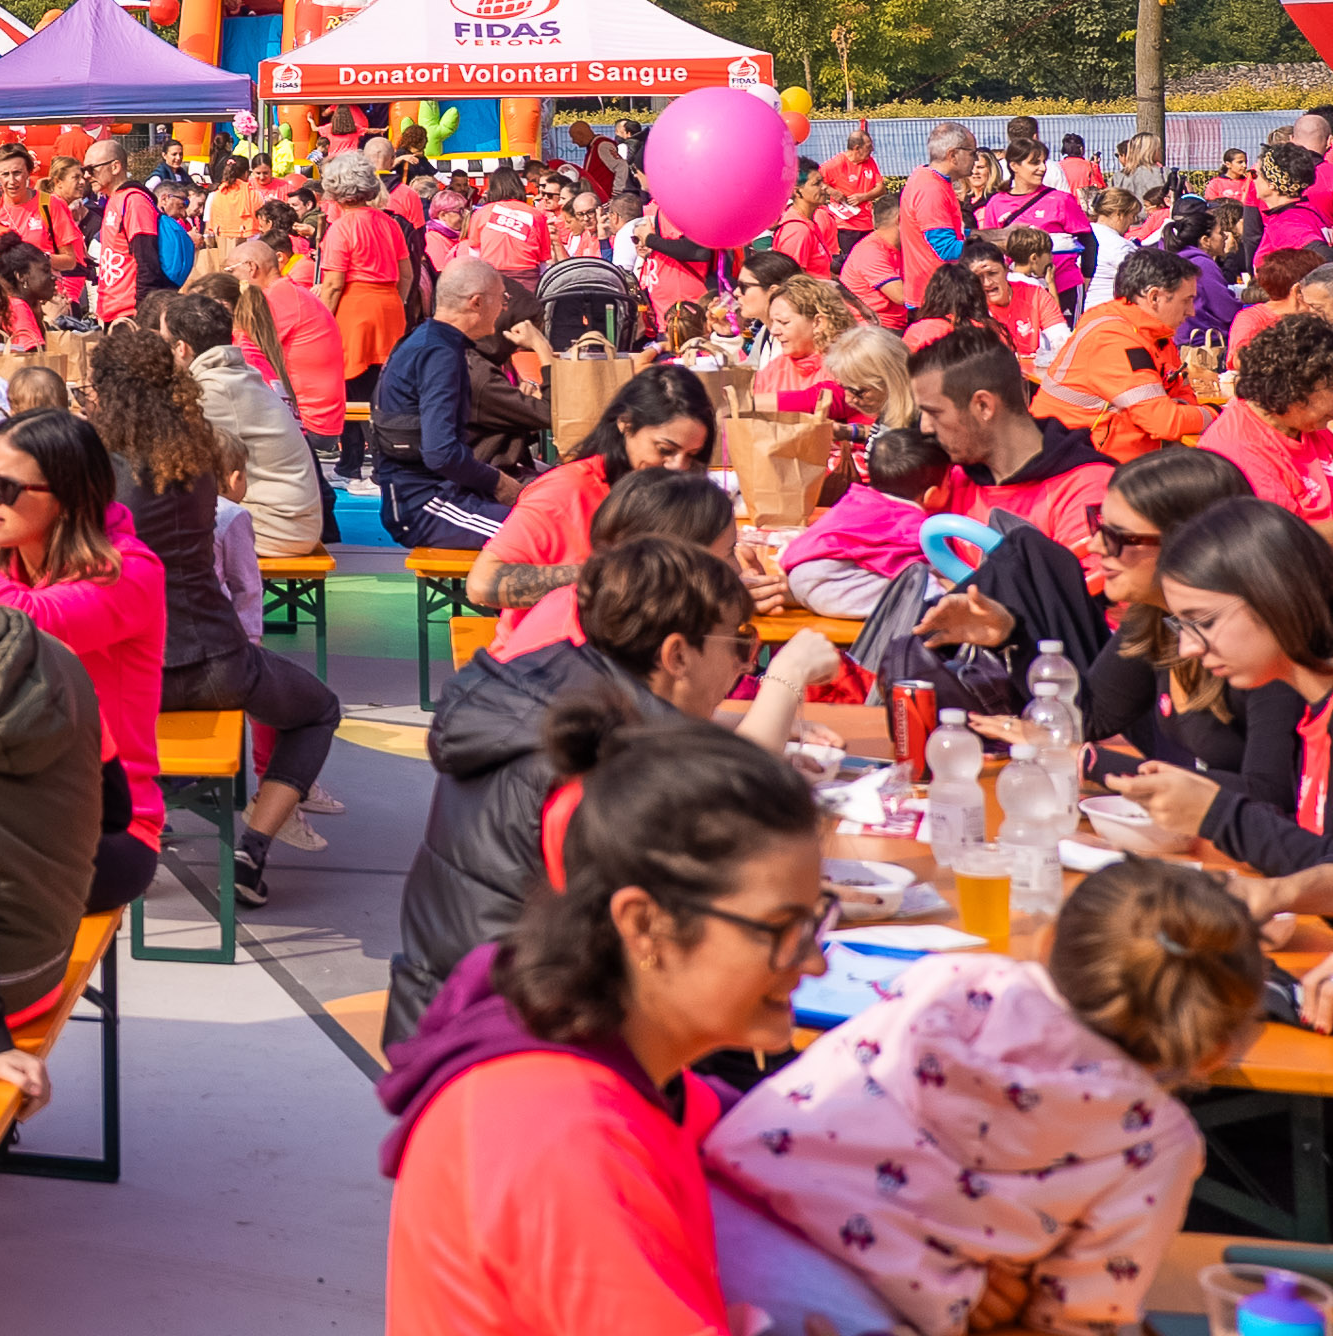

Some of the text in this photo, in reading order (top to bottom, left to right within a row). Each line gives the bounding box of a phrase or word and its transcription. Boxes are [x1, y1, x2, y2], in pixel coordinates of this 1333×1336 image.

[454, 20, 561, 38] FIDAS
[455, 37, 562, 47] VERONA
[338, 61, 688, 87] Donatori Volontari Sangue
[731, 77, 757, 85] FIDAS
